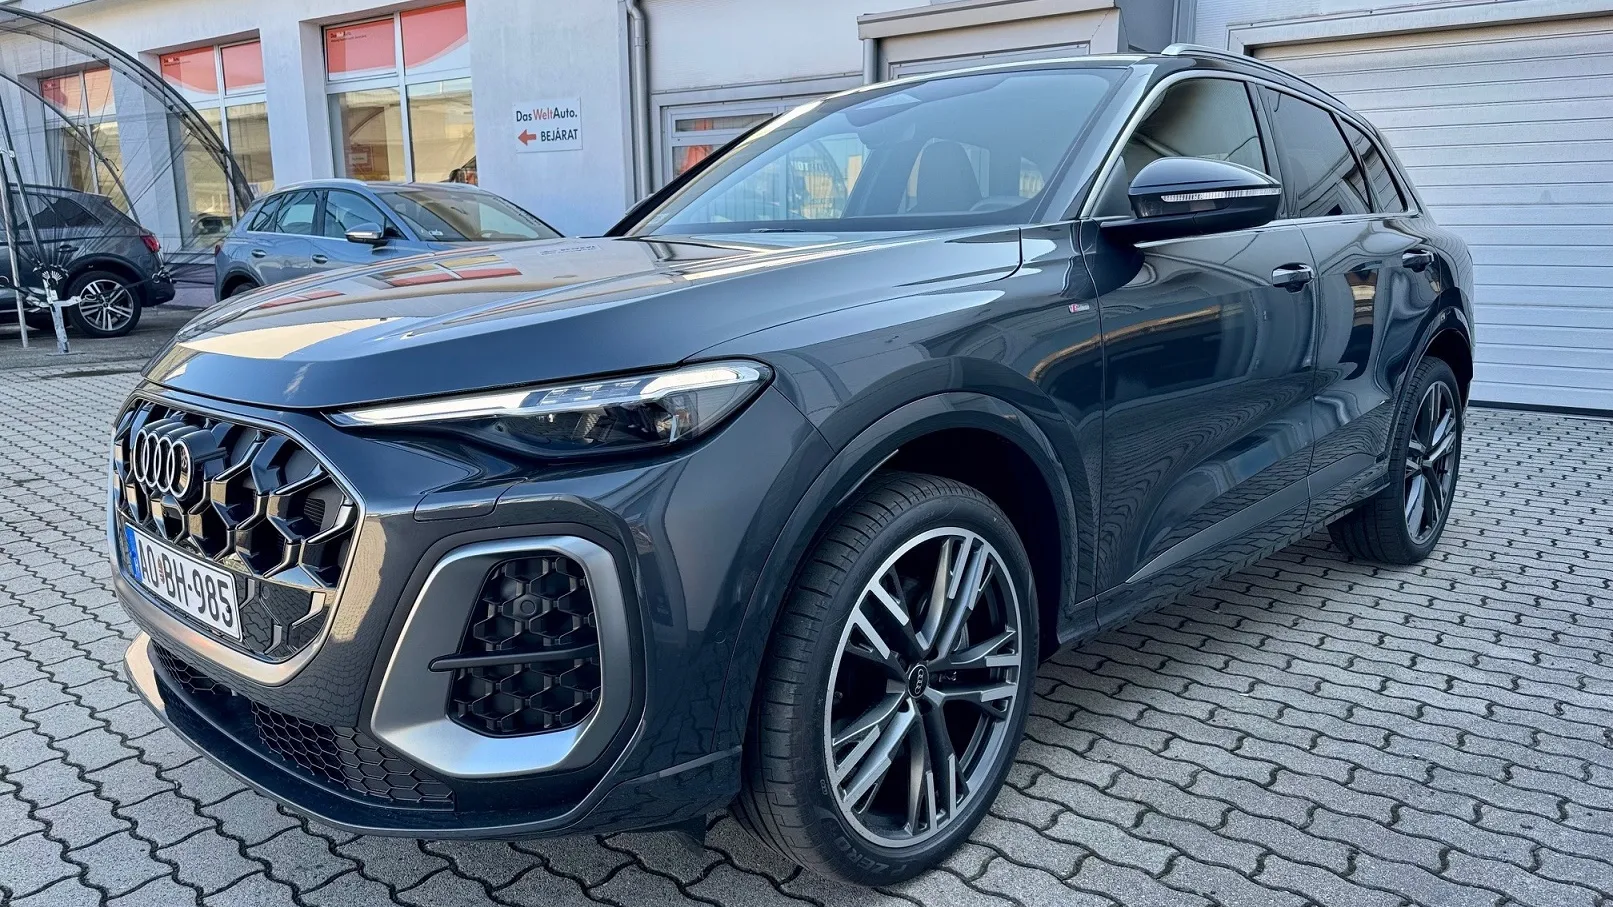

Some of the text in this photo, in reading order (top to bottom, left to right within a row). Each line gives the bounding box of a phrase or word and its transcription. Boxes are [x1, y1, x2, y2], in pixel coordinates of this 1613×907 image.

[516, 110, 532, 122] Das
[540, 127, 578, 142] BEJÁRAT
[834, 836, 890, 874] ZERO
